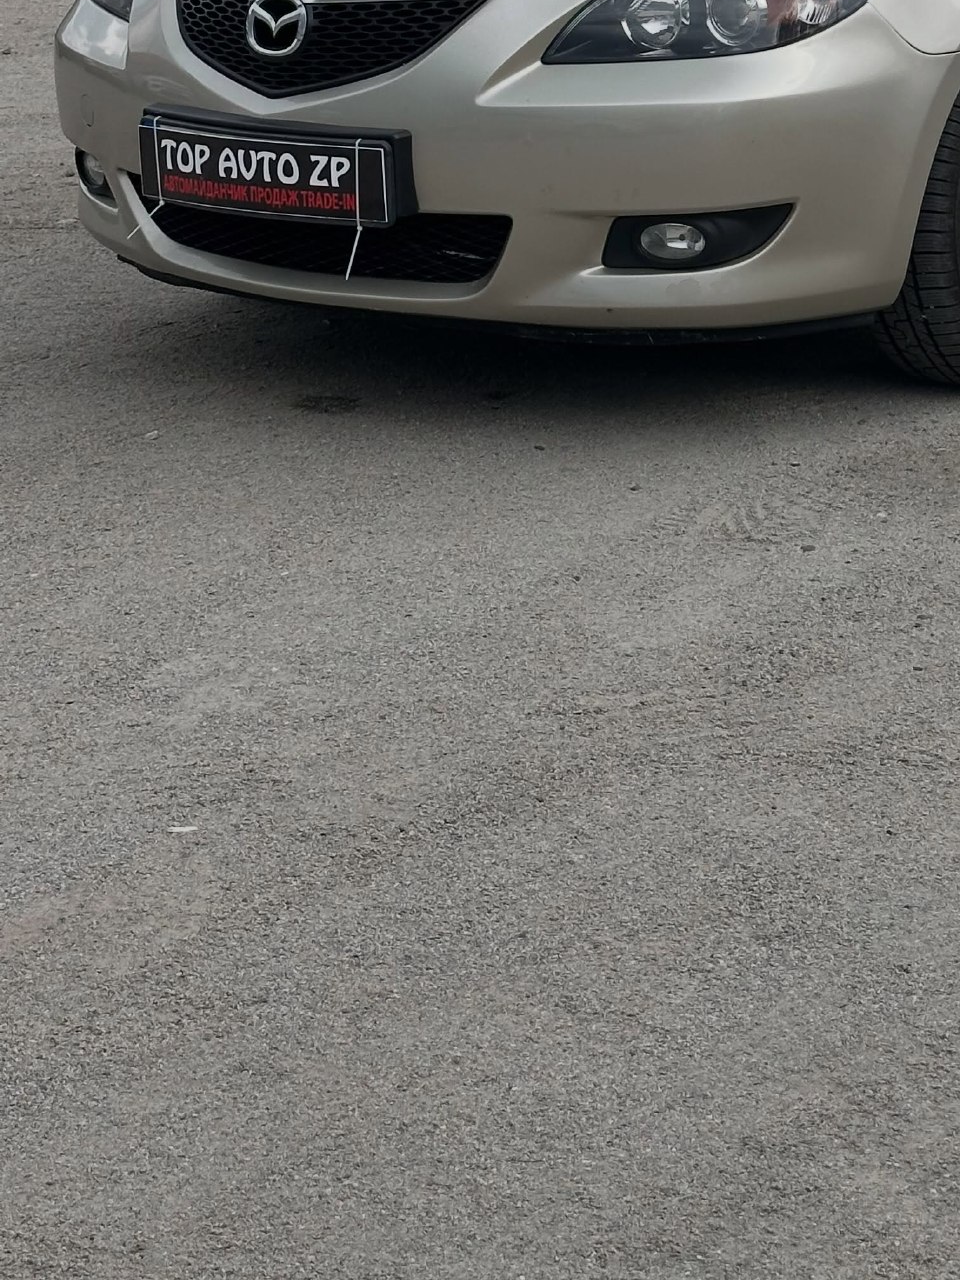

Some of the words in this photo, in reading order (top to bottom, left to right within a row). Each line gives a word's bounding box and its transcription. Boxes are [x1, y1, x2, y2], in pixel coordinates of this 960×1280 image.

[161, 138, 210, 175] TOP
[309, 155, 350, 187] ZP
[164, 174, 248, 201] АВТОМАЙДАНЧИК
[250, 187, 300, 208] ПРОДАЖ
[301, 190, 355, 210] TRADE-IN
